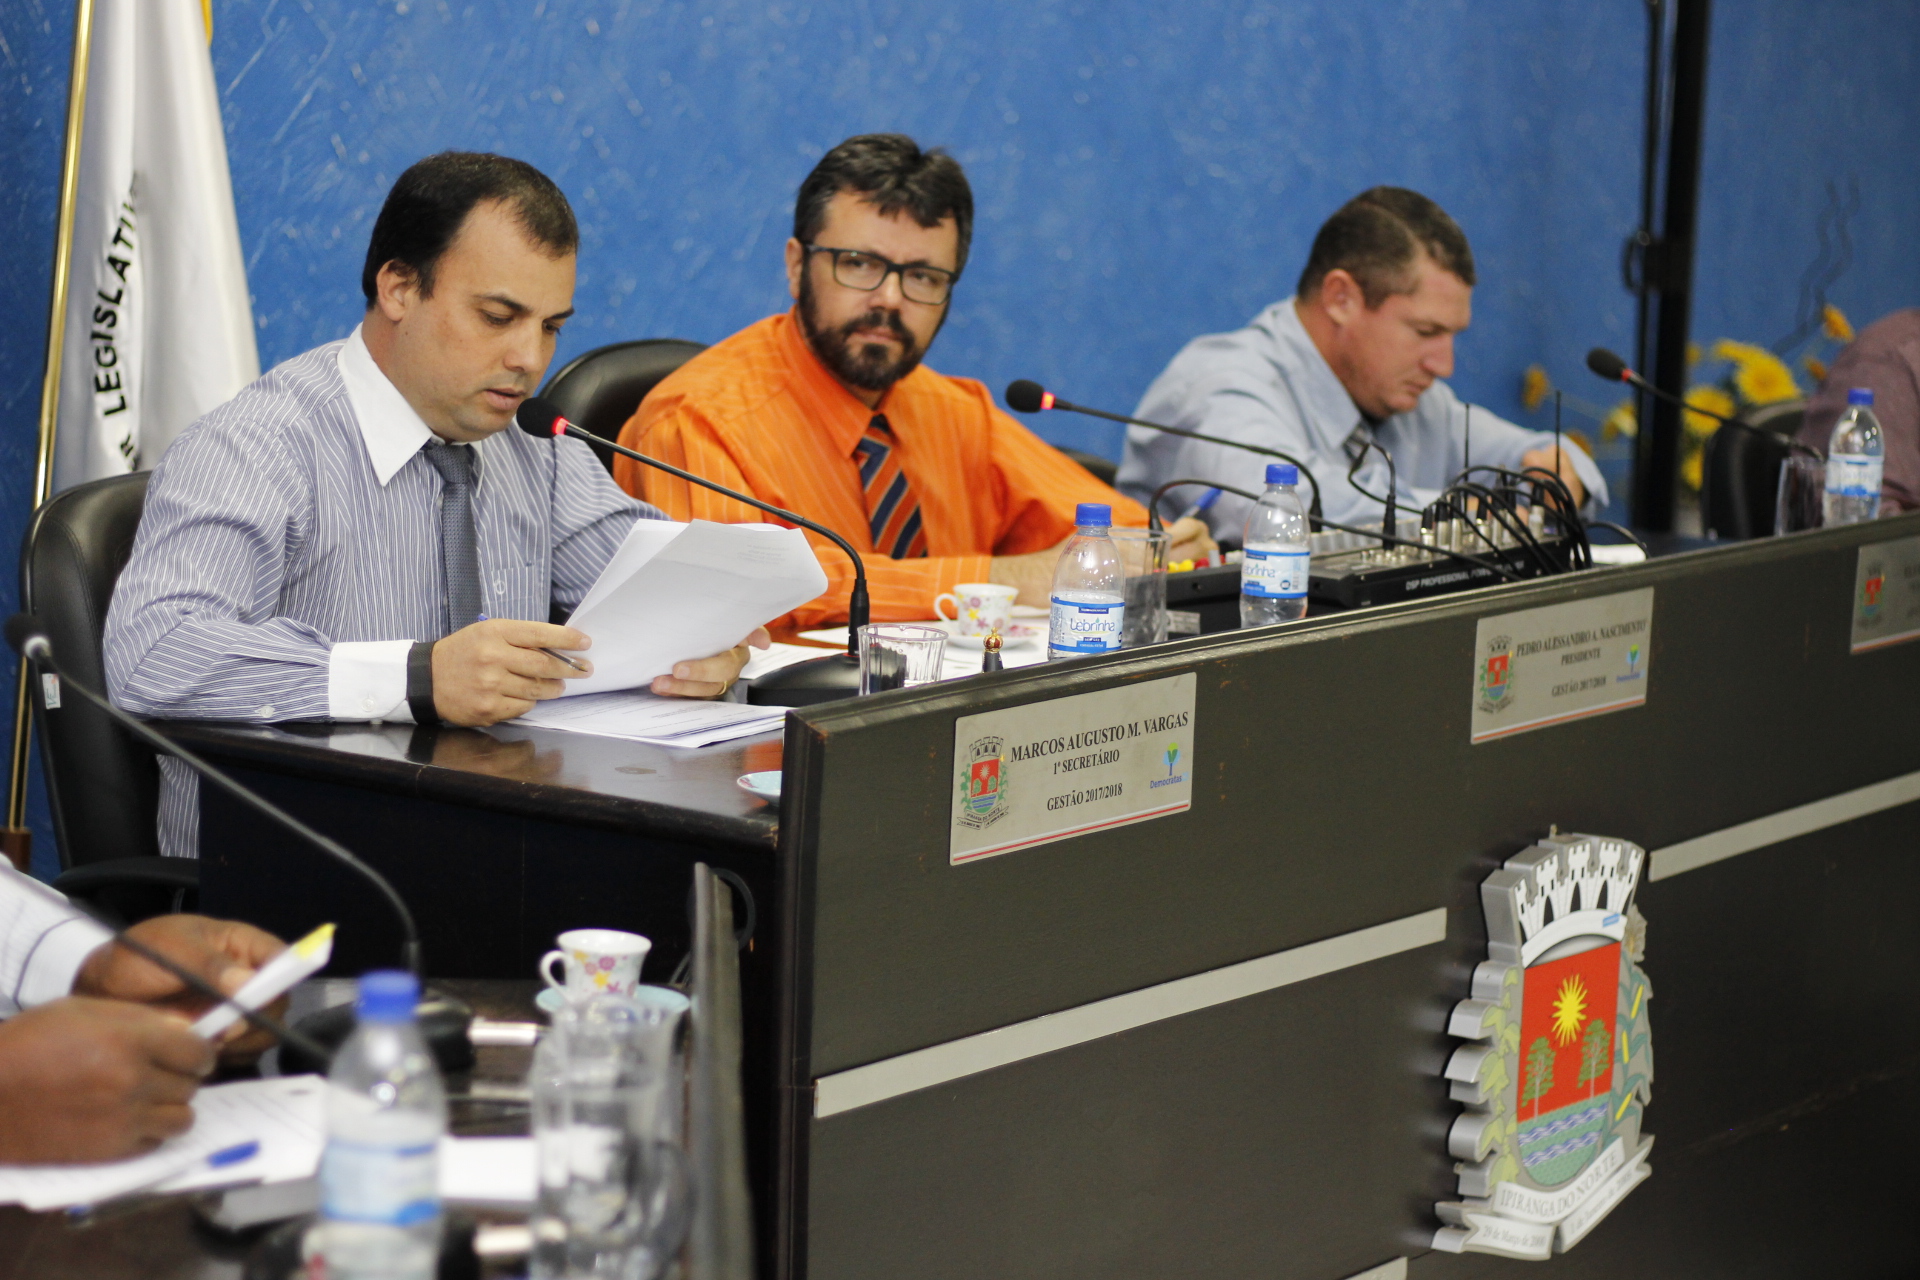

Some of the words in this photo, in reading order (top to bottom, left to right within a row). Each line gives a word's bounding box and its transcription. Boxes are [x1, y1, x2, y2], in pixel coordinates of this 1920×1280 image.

[1420, 571, 1470, 588] PROFESSIONAL
[1070, 617, 1115, 632] Lebrinha
[1516, 639, 1542, 657] PEDRO
[1543, 630, 1591, 651] ALESSANDRO
[1600, 619, 1647, 639] NASCIMENTO
[1561, 647, 1601, 666] PRESIDENTE
[1551, 678, 1579, 698] GESTÃO
[1010, 737, 1065, 763] MARCOS
[1066, 725, 1125, 751] AUGUSTO
[1127, 721, 1141, 738] M.
[1143, 711, 1189, 735] VARGAS
[1062, 749, 1120, 774] SECRETÁRIO
[1150, 776, 1182, 789] Democratas
[1046, 790, 1084, 811] GESTÃO
[1085, 783, 1123, 803] 2017/2018
[1500, 1189, 1555, 1218] IPIRANGA
[1557, 1190, 1576, 1214] DO
[1576, 1152, 1617, 1197] NORTE
